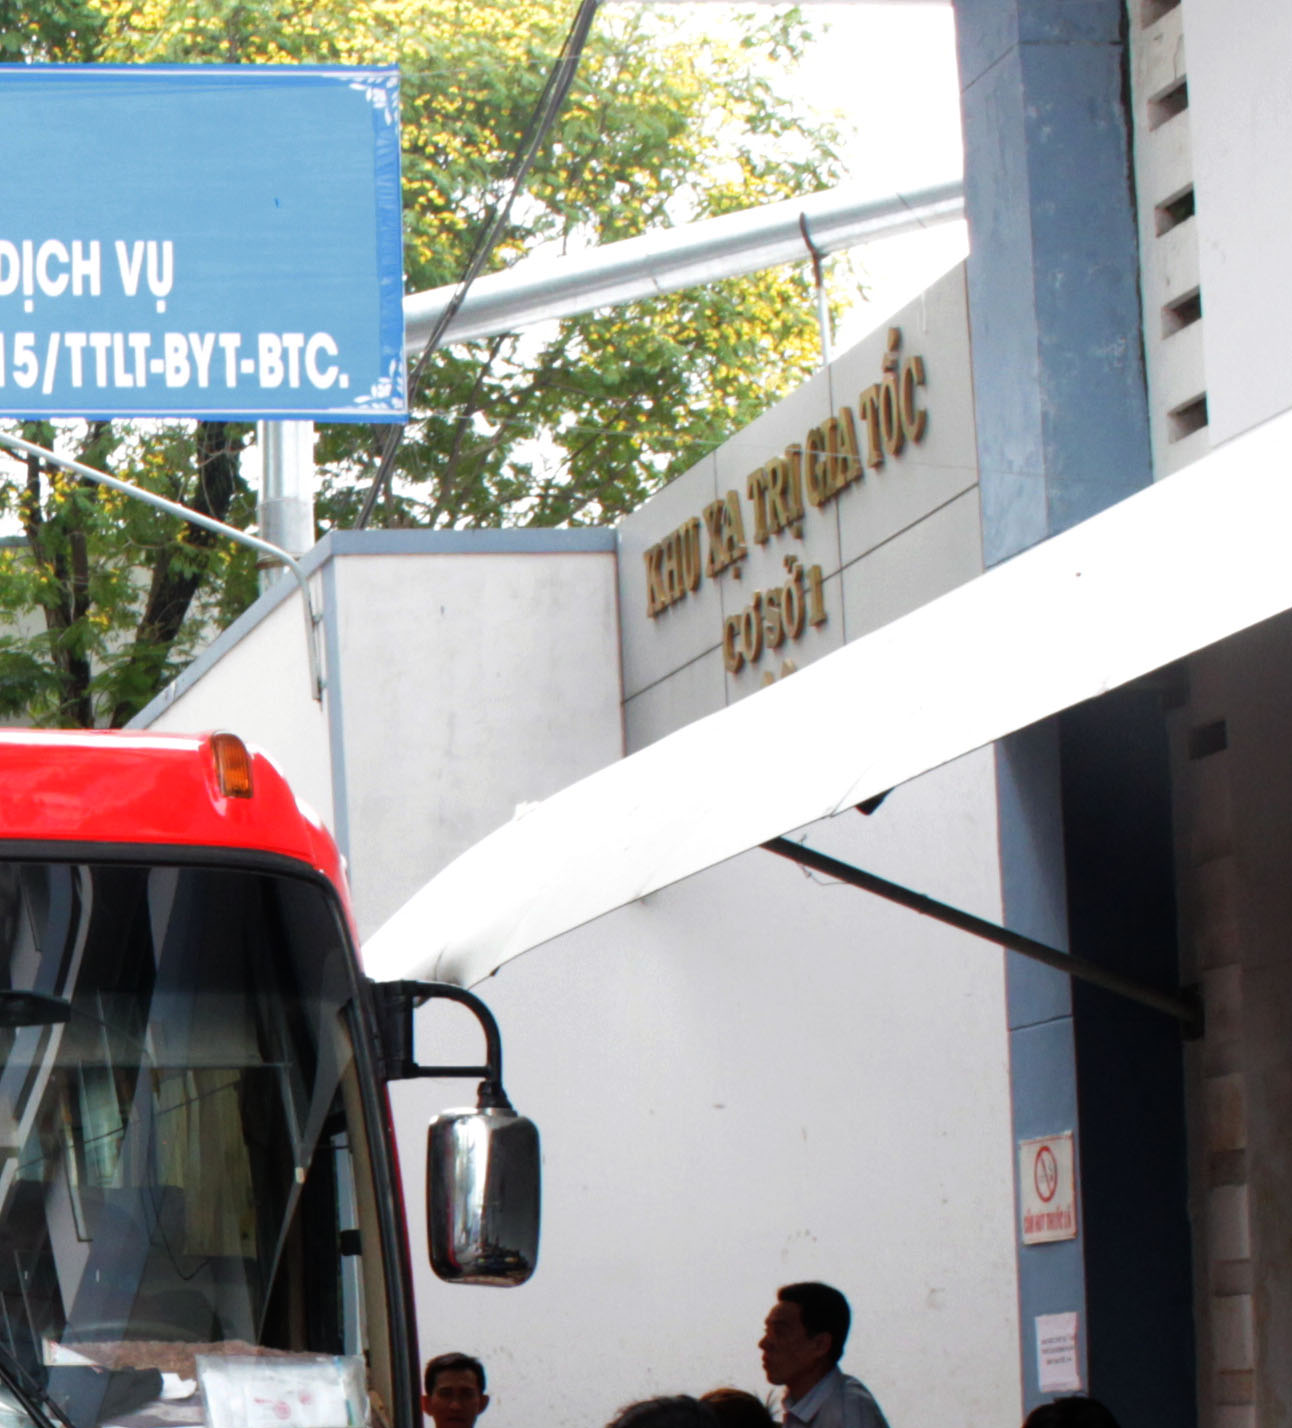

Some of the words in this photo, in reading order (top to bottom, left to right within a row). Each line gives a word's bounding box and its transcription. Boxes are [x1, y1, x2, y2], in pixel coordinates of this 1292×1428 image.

[114, 240, 175, 314] VỤ
[643, 516, 701, 619] KHU
[747, 443, 806, 545] TRỊ
[805, 406, 864, 508] GIA
